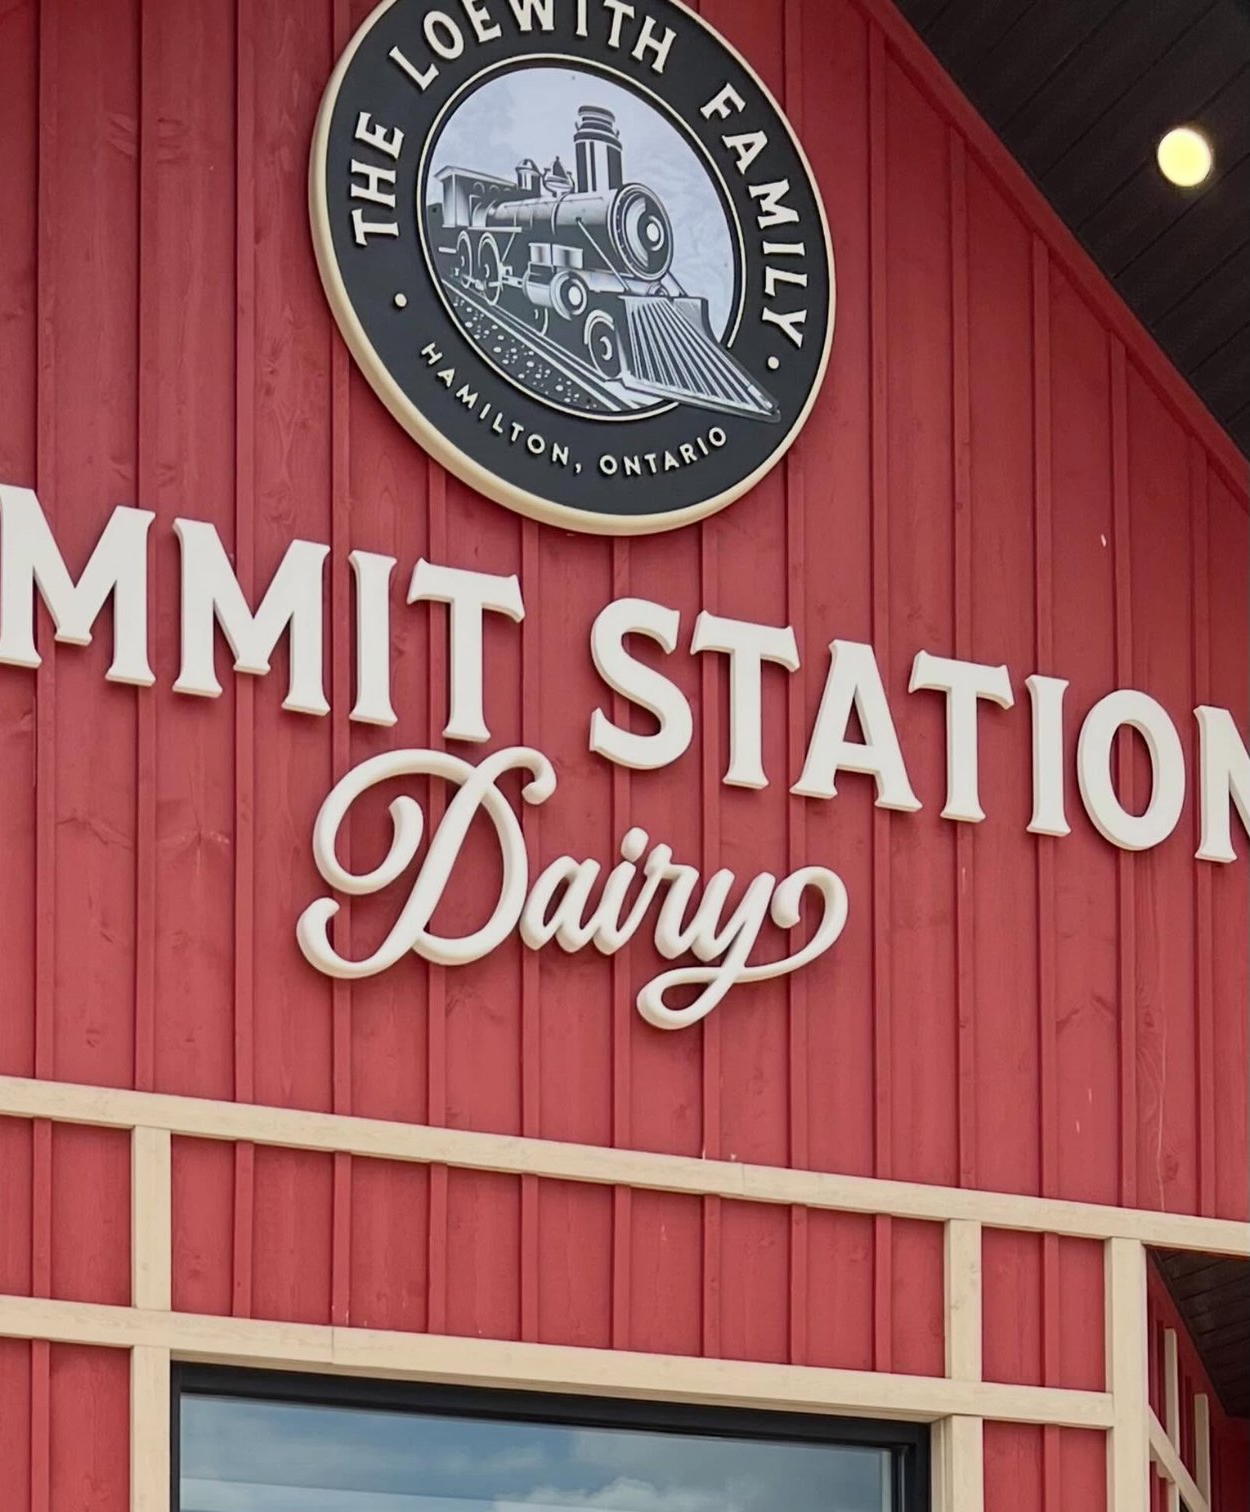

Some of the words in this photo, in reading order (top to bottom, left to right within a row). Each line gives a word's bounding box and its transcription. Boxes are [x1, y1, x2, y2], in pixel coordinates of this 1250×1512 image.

[350, 111, 404, 248] THE
[388, 0, 678, 92] LOEWITH
[700, 83, 809, 351] FAMILY
[420, 342, 583, 475] HAMILTON,
[599, 426, 728, 477] ONTARIO
[295, 746, 849, 1031] Dairy
